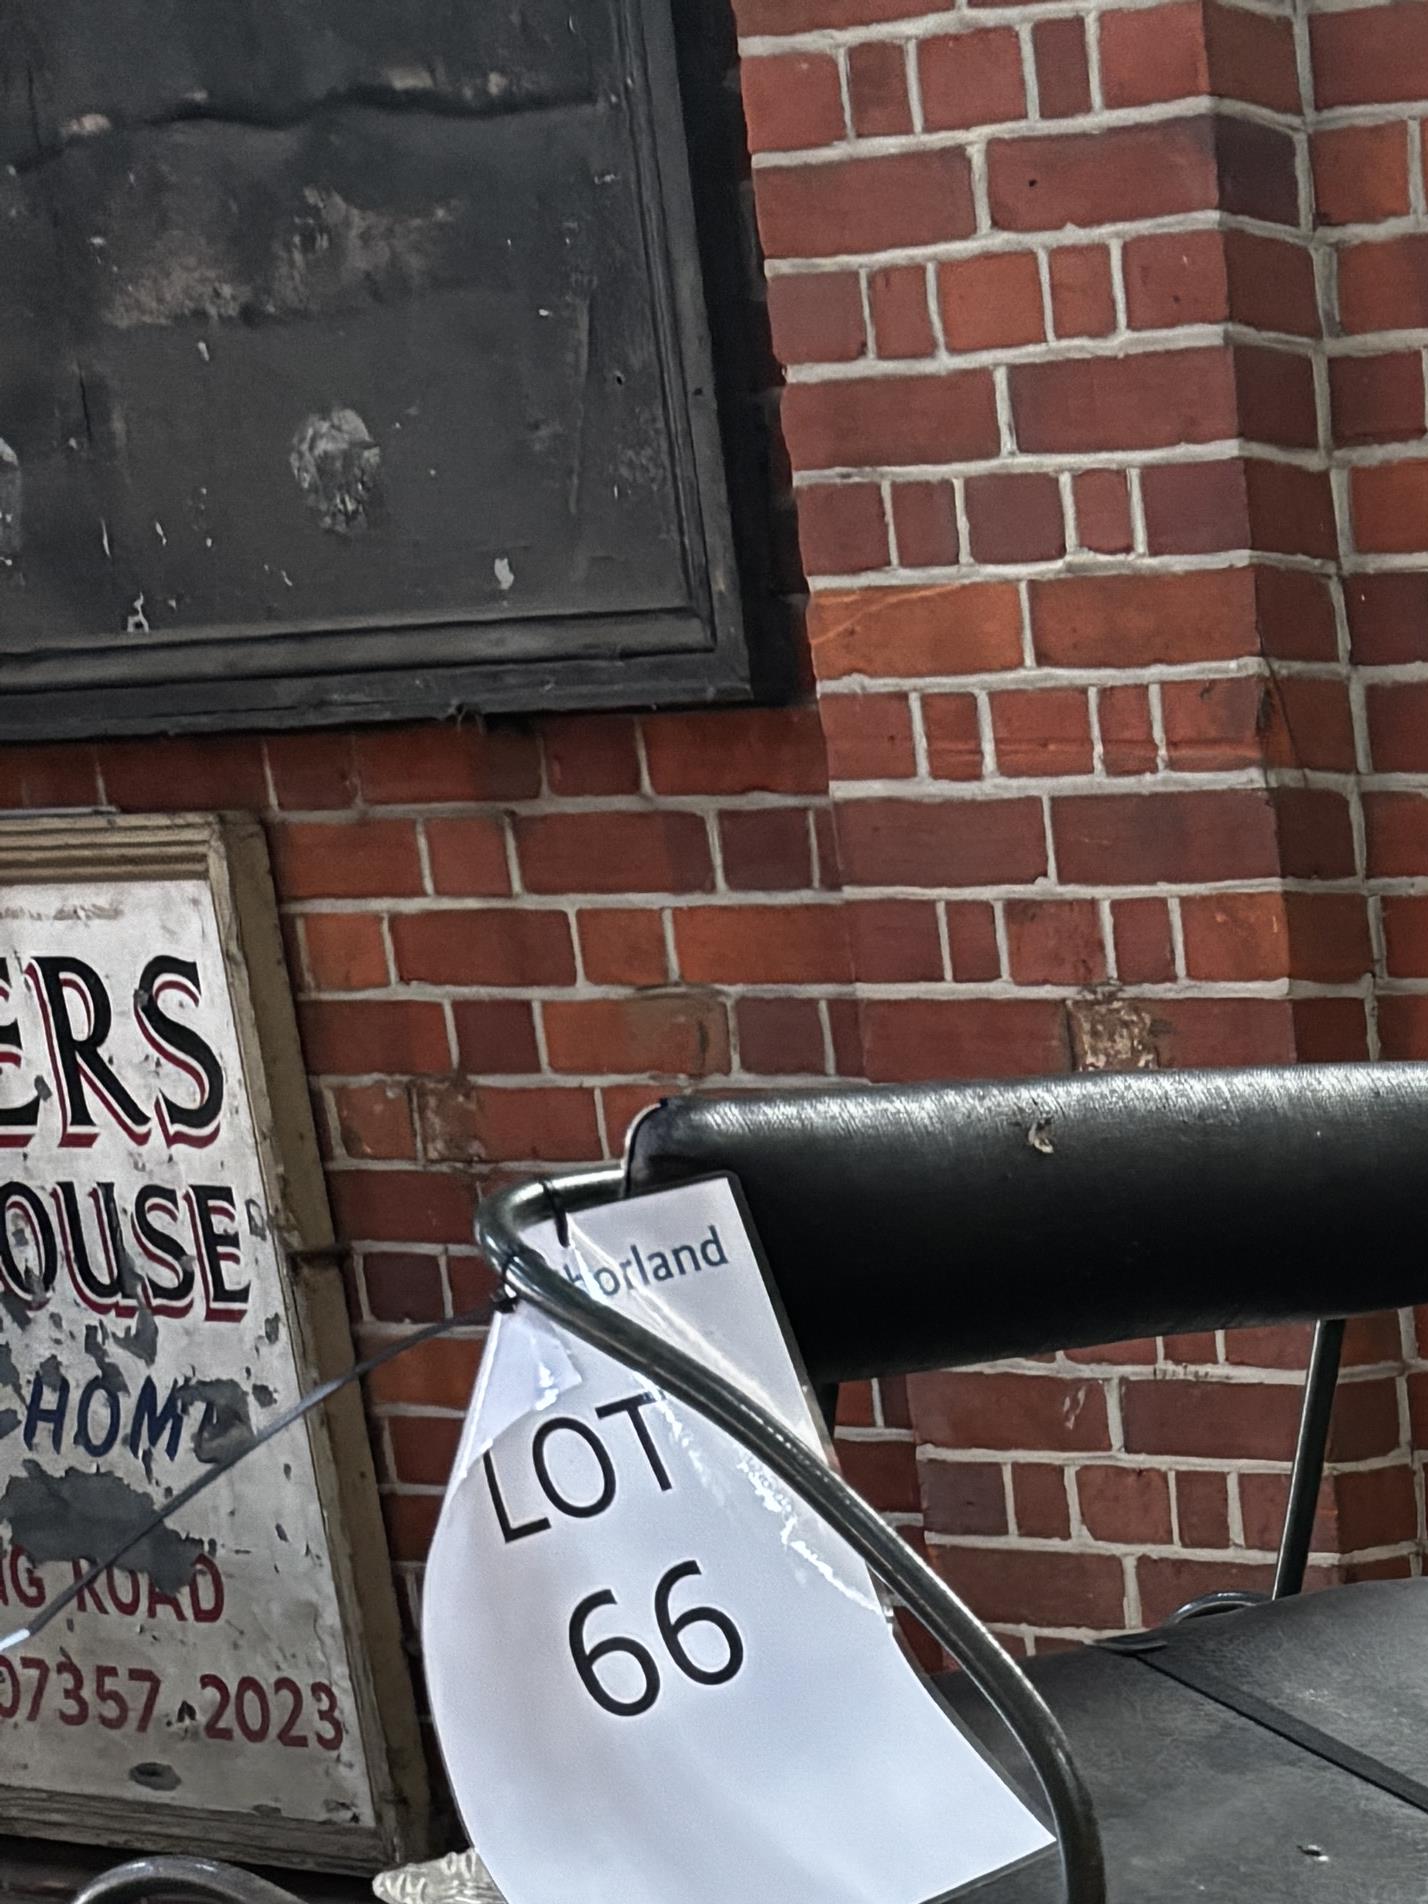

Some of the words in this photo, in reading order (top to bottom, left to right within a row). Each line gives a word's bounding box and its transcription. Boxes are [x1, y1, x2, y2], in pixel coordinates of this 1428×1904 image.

[0, 1180, 251, 1322] OUSE
[482, 1391, 672, 1544] LOT
[199, 1672, 344, 1751] 2023
[568, 1559, 744, 1717] 66
